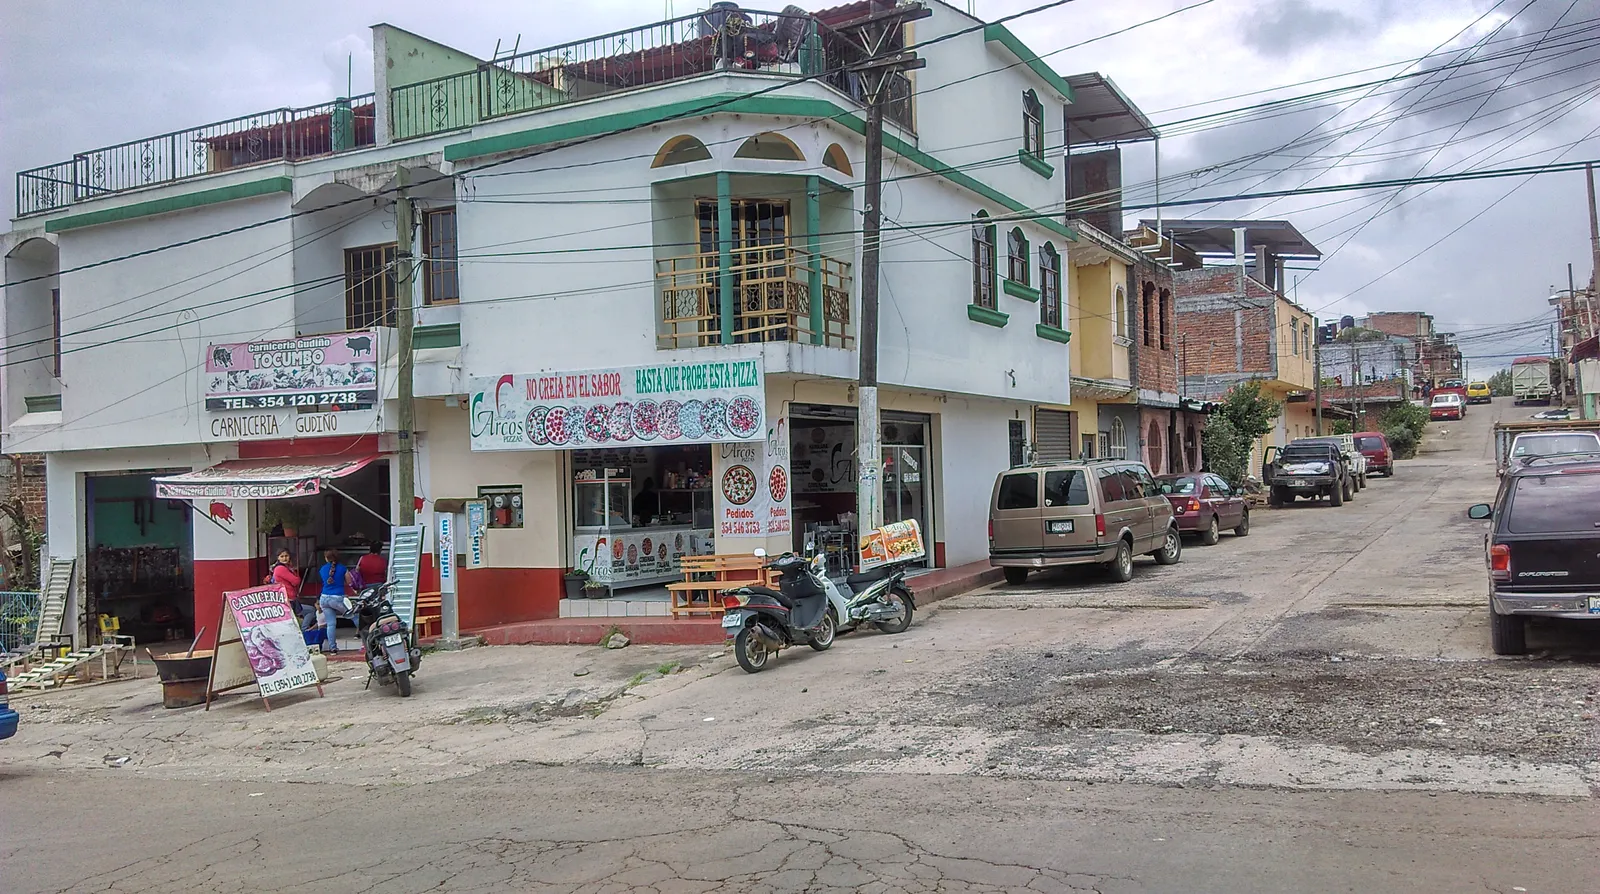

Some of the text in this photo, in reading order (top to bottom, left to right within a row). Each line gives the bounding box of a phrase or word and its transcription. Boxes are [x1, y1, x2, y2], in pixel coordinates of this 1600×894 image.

[248, 337, 331, 352] Carniceria Gudiño
[253, 350, 325, 368] TOCUMBO
[526, 378, 537, 400] NO
[566, 376, 577, 398] EN
[579, 374, 590, 398] EL
[592, 372, 622, 396] SABOR
[636, 361, 758, 394] HASTA QUE PROBE ESTA PIZZA
[223, 392, 357, 410] TEL. 354 120 2738
[211, 414, 337, 437] CARNICERIA GUDIÑO
[472, 409, 523, 438] Arcos
[722, 442, 755, 458] Arcos
[232, 485, 298, 498] TOCUMBO
[726, 508, 754, 518] Pedidos
[722, 521, 760, 534] 354 546 3753
[232, 592, 285, 610] CARNICERIA
[243, 605, 285, 622] TOCUMBO
